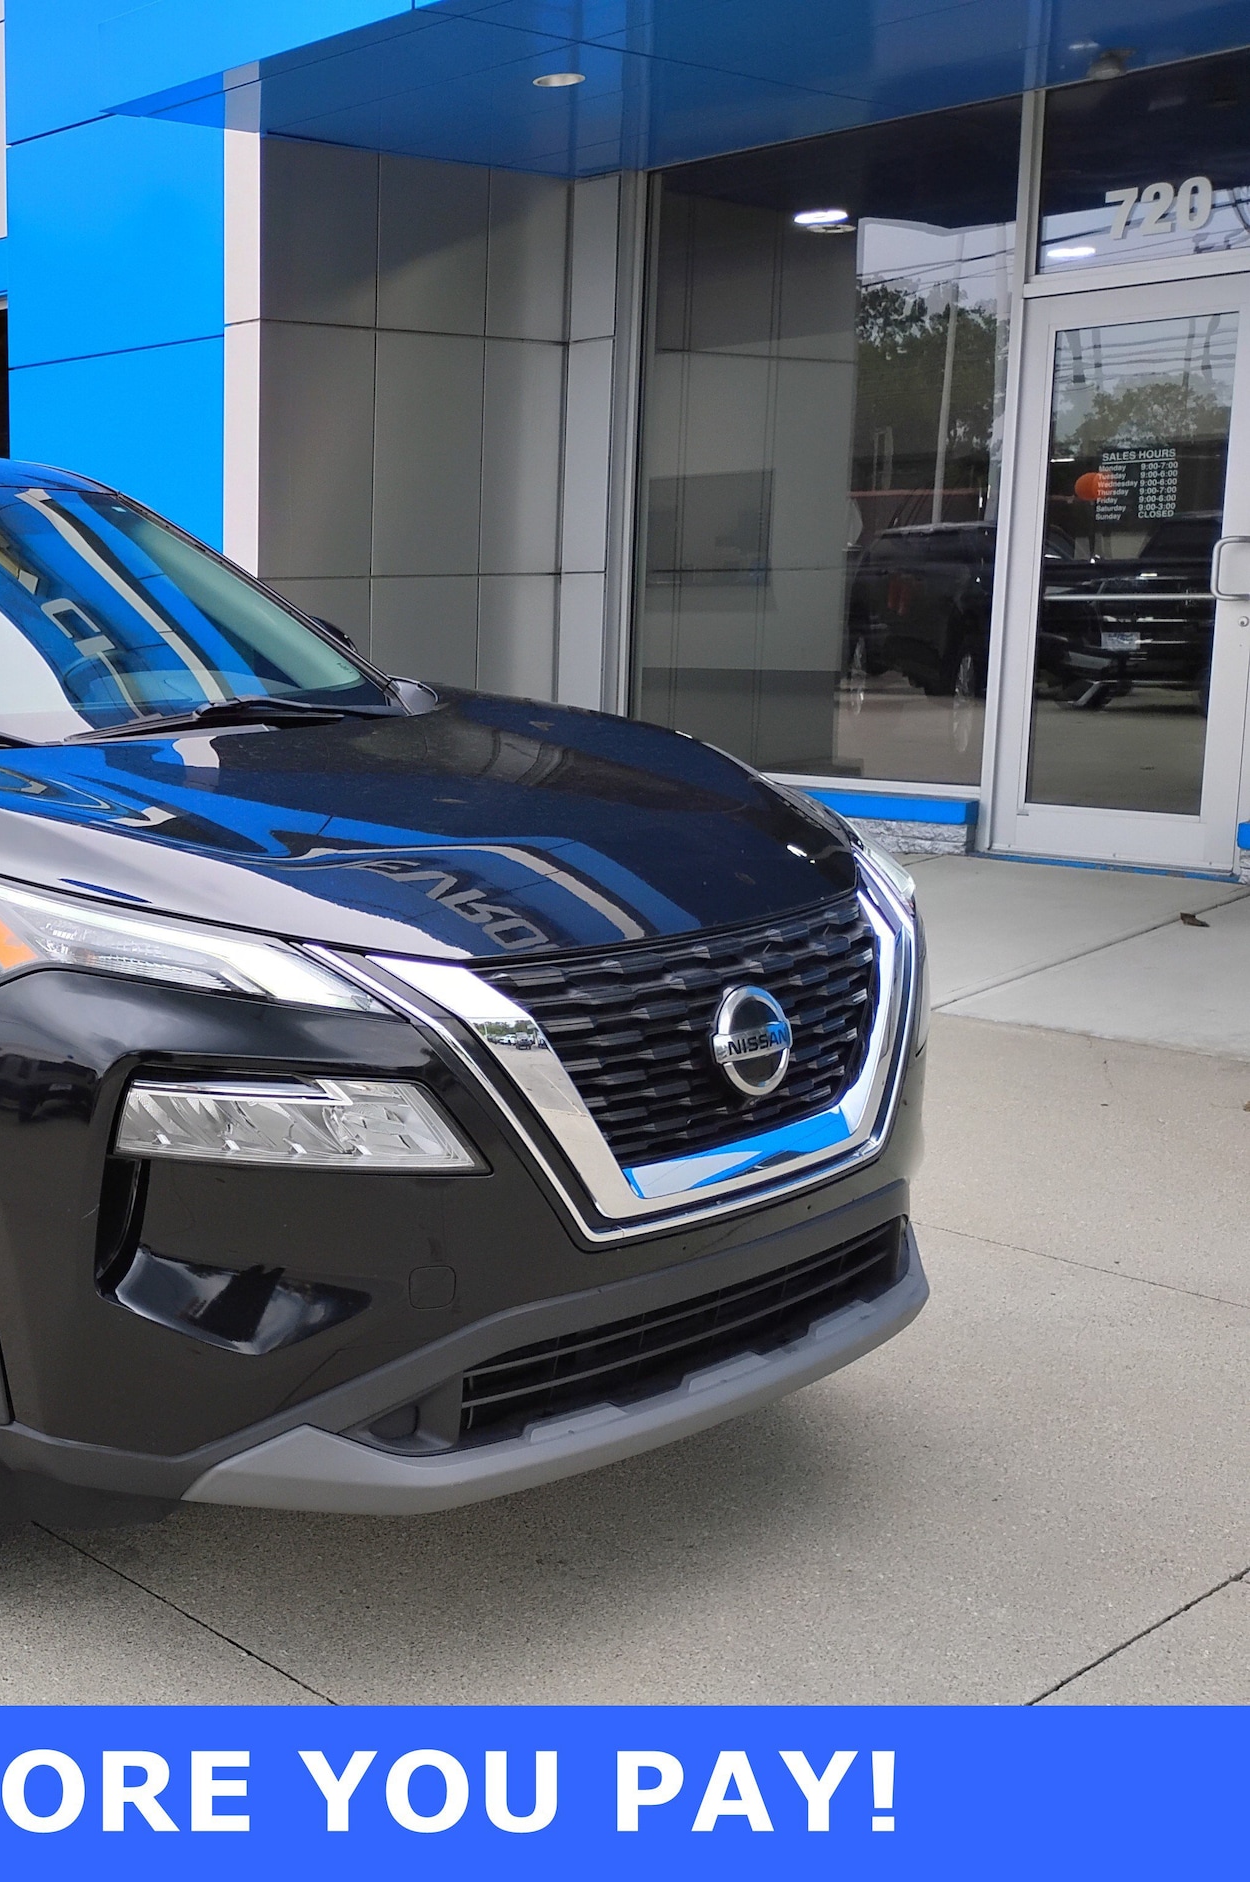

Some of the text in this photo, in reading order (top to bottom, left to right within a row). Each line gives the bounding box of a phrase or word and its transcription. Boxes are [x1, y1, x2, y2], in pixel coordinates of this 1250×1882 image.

[1105, 176, 1213, 240] 720
[1102, 448, 1176, 462] SALES HOURS
[1098, 465, 1127, 473] Monday
[1098, 472, 1127, 480] Tuesday
[1097, 480, 1138, 488] Wednesday
[1097, 488, 1129, 497] Thursday
[1096, 497, 1118, 505] Friday
[1096, 504, 1127, 513] Saturday
[1095, 510, 1175, 521] Sunday CLOSED
[727, 1027, 788, 1056] NISSAN
